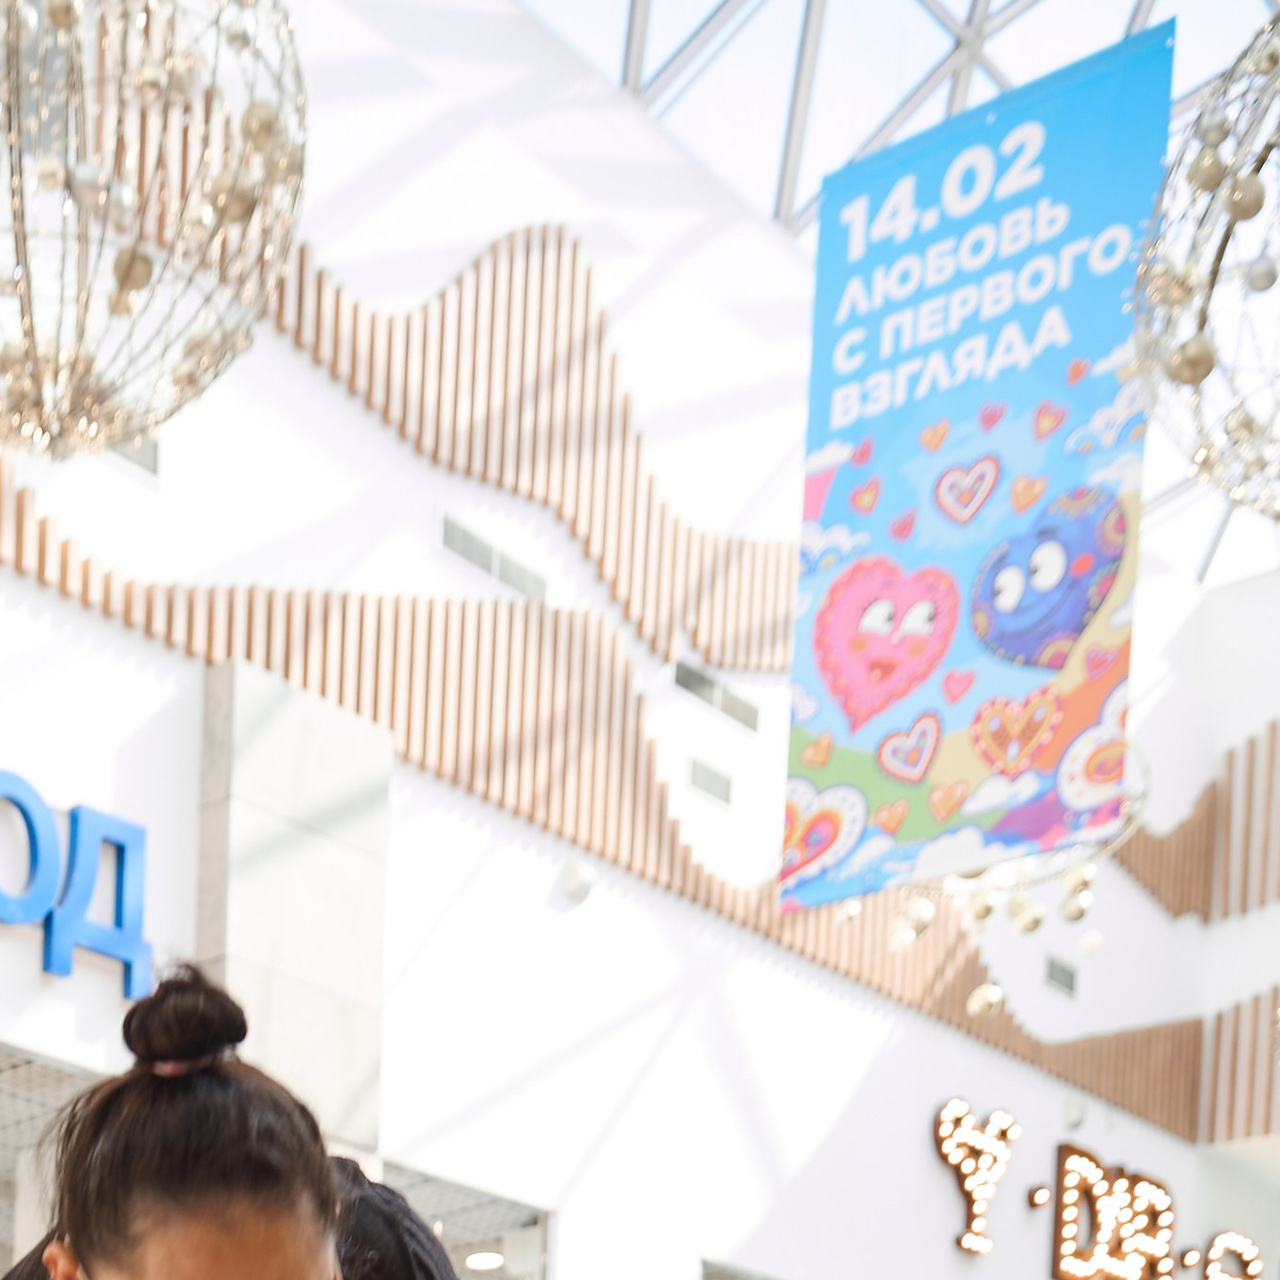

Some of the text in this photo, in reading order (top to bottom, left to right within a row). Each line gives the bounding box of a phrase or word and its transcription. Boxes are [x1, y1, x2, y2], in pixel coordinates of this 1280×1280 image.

[838, 119, 1047, 265] 14.02
[831, 223, 1133, 376] С ПЕРВОГО
[833, 196, 1072, 327] ЛЮБОВЬ
[828, 304, 1072, 432] ВЗГЛЯДА
